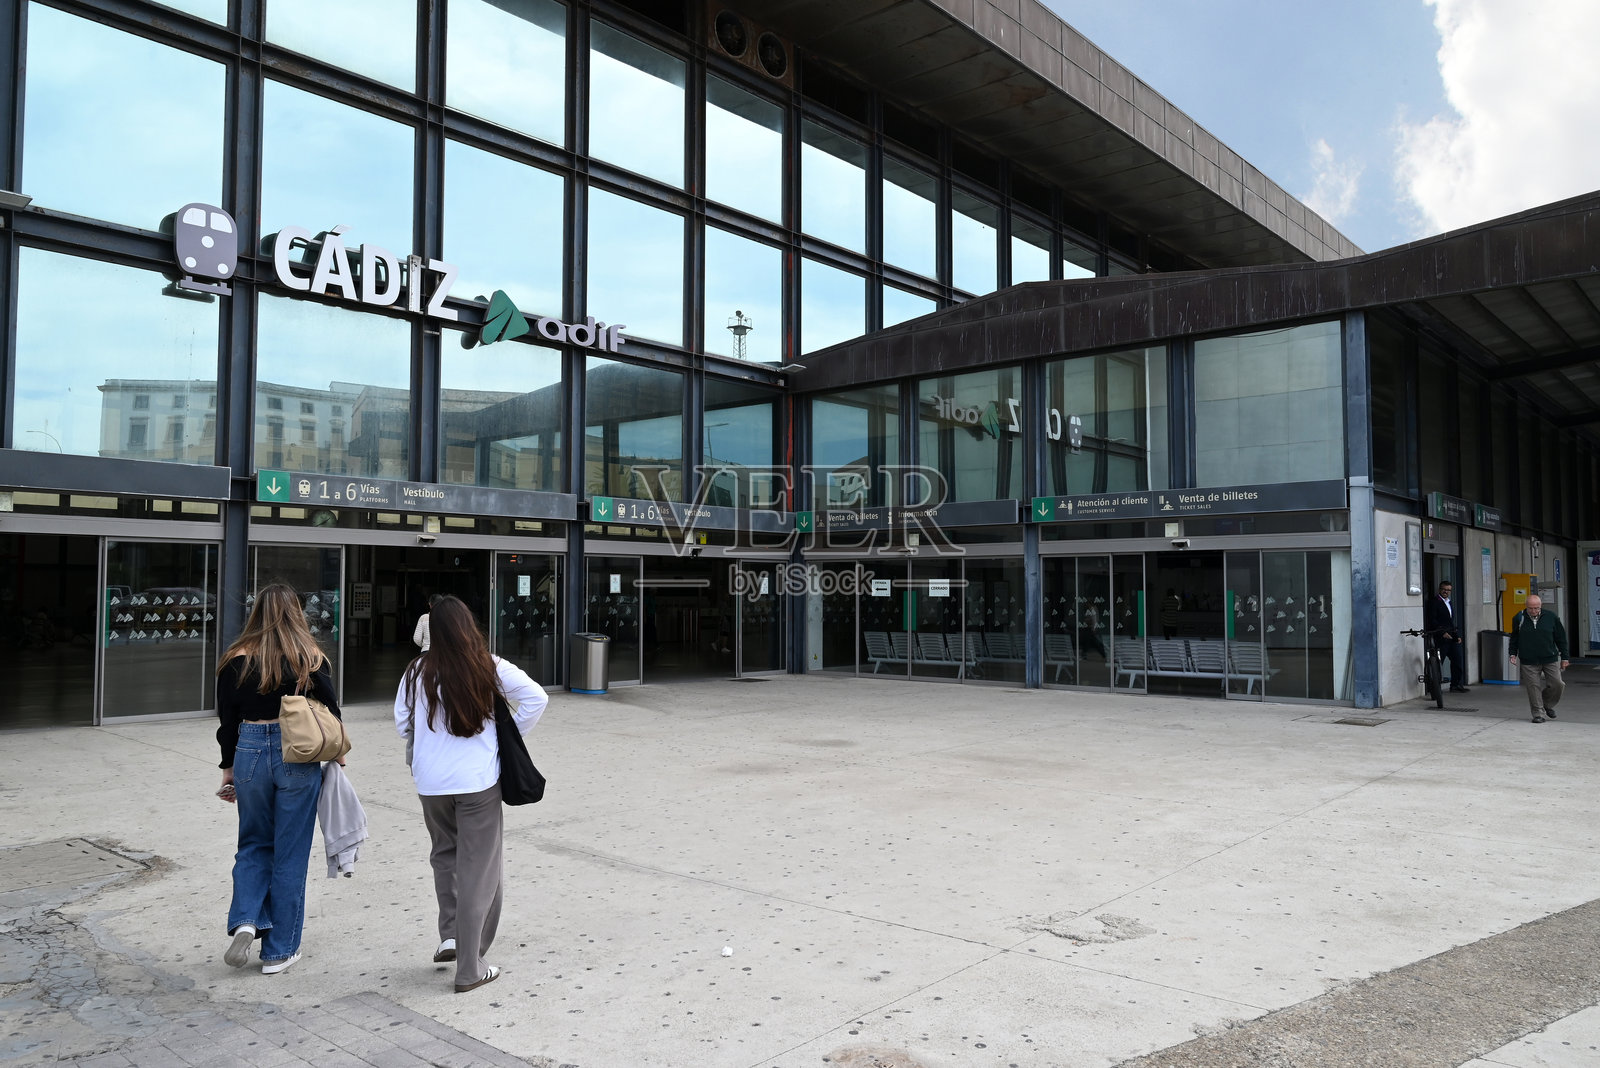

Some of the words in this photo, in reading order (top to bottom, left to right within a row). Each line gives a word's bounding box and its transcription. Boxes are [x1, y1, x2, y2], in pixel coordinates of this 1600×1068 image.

[274, 224, 459, 321] CÁDIZ
[537, 316, 627, 352] adif
[319, 481, 330, 499] 1
[334, 491, 341, 500] a
[346, 482, 356, 501] 6
[360, 484, 380, 494] Vías
[403, 487, 445, 499] Vestíbulo
[1179, 494, 1205, 503] Venta
[1208, 493, 1220, 502] de
[1222, 491, 1258, 501] billetes
[359, 496, 389, 504] PLATFORMS
[1077, 498, 1110, 507] Atención
[1112, 498, 1119, 506] al
[1121, 496, 1149, 505] cliente
[631, 504, 638, 519] 1
[647, 505, 655, 520] 6
[847, 513, 855, 521] de
